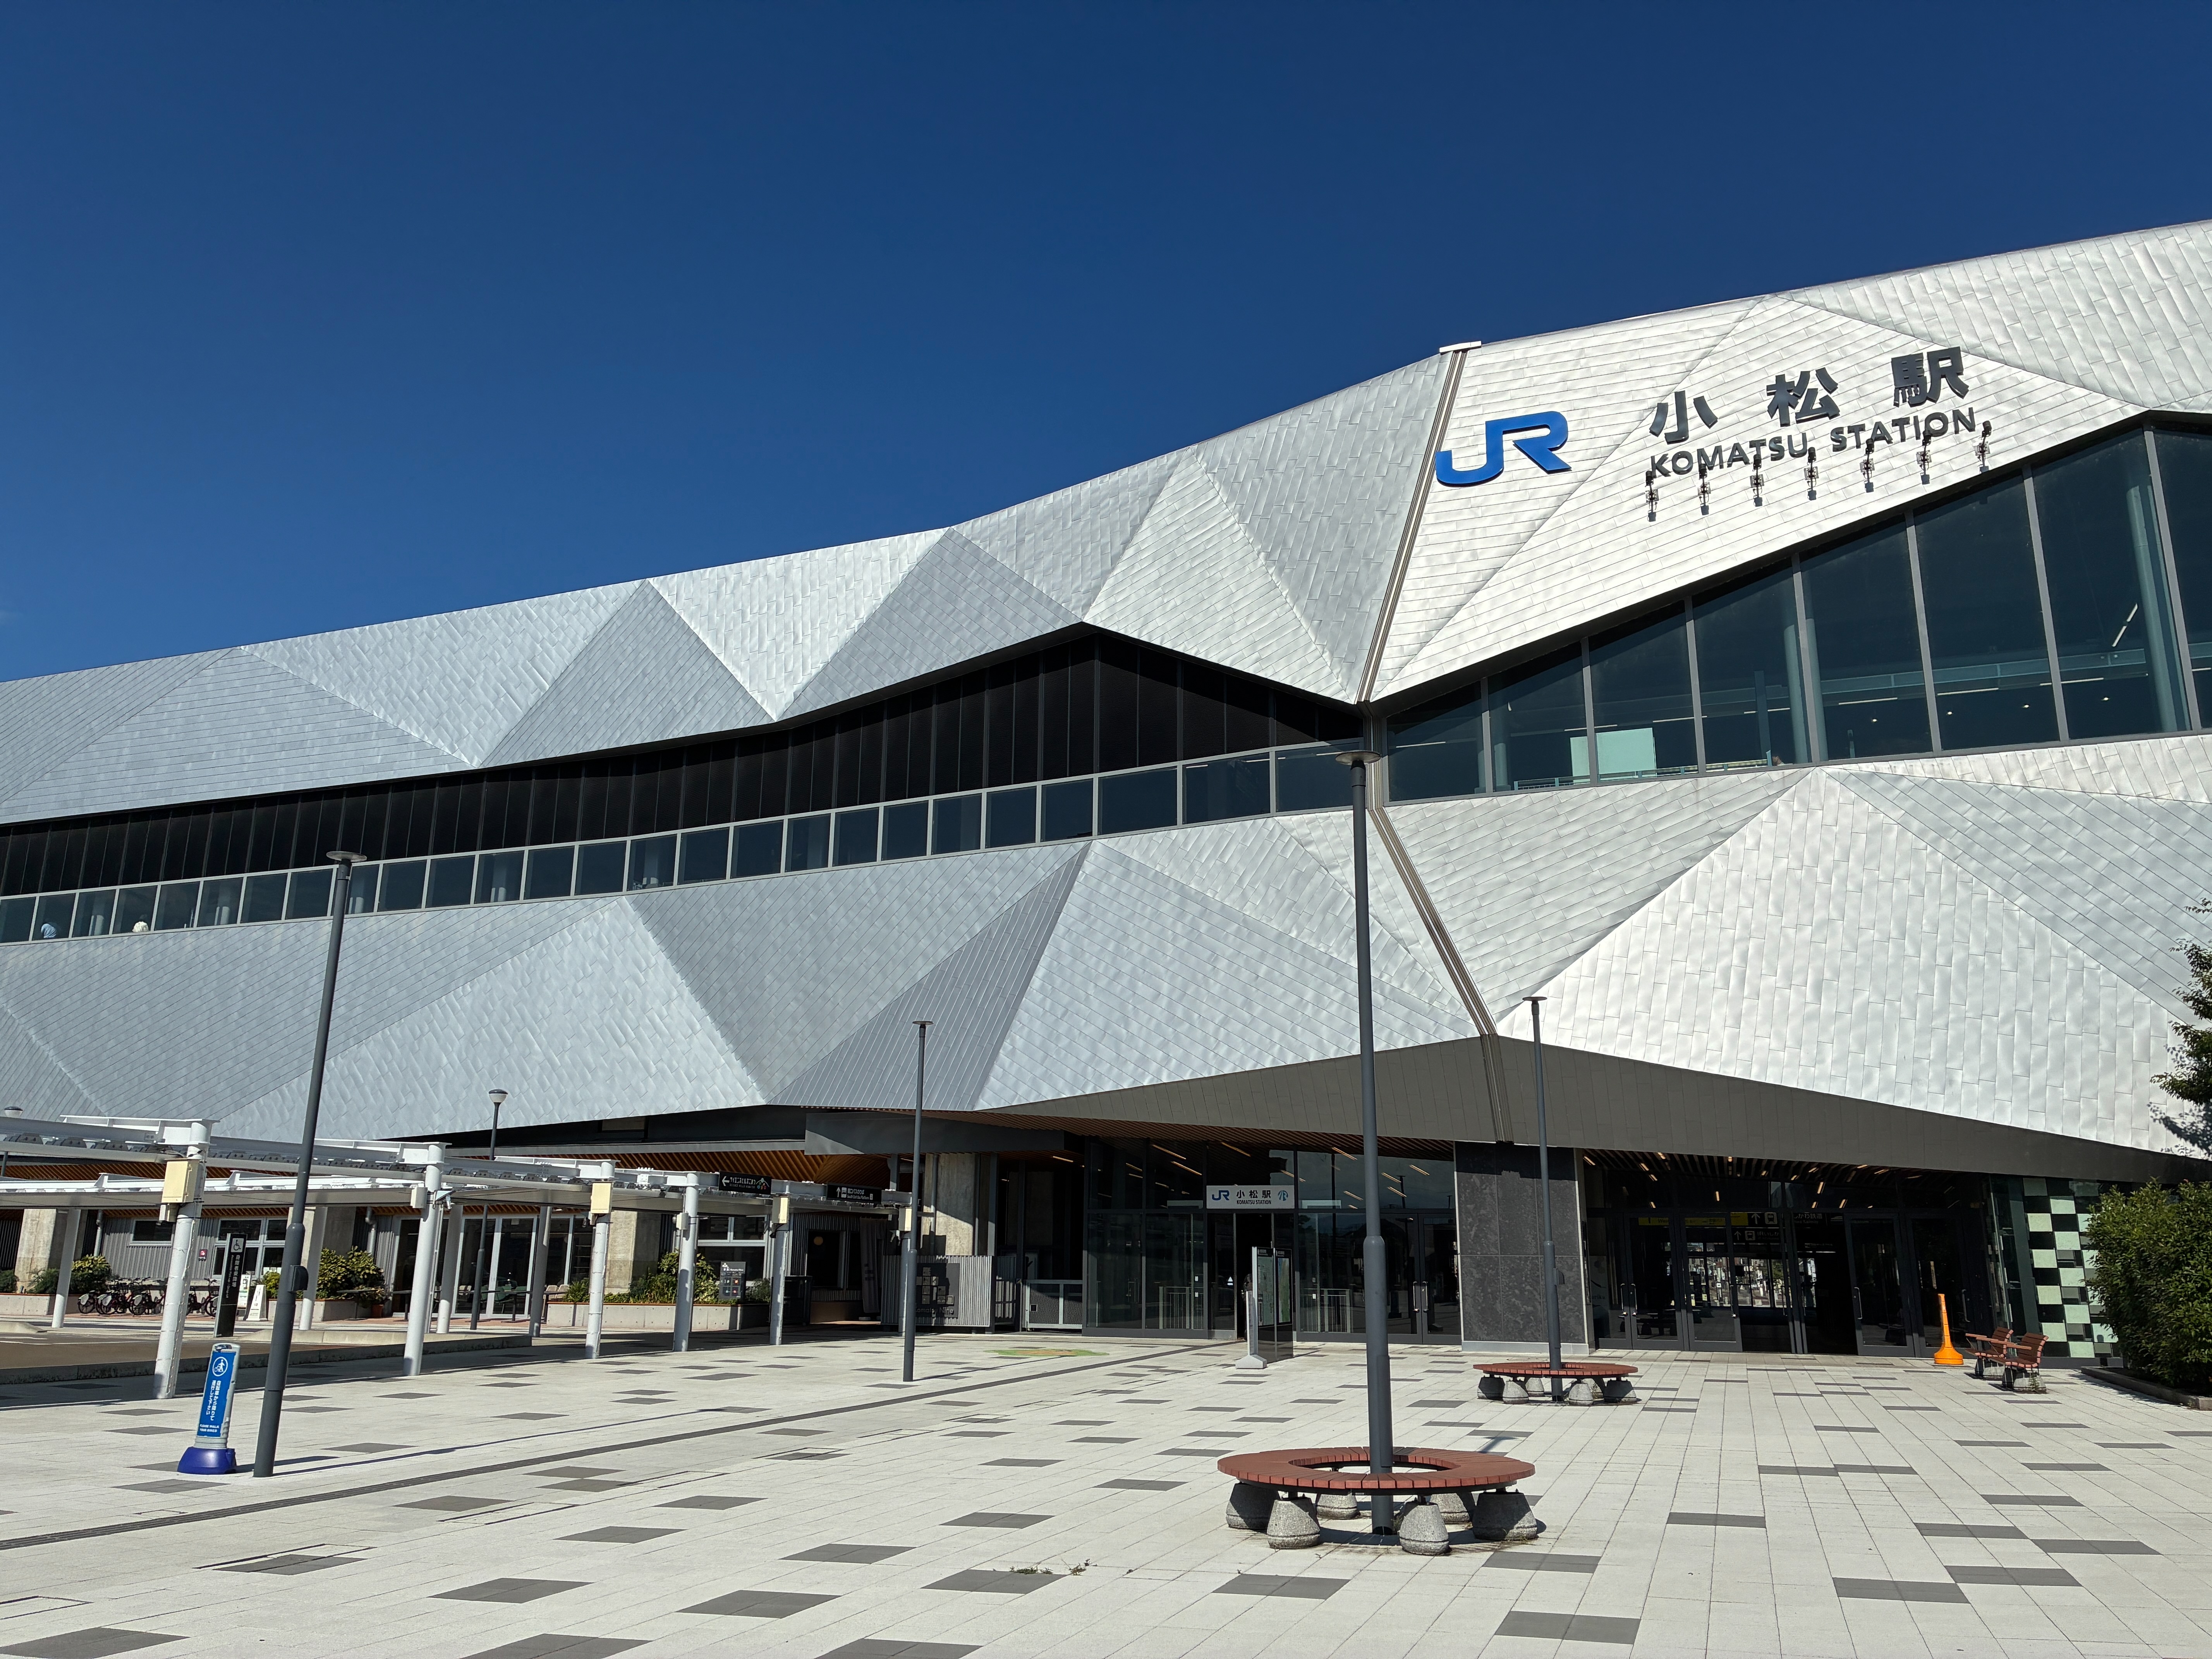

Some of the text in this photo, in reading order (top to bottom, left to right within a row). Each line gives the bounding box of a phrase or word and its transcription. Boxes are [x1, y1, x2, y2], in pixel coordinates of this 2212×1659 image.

[1649, 347, 1969, 445] 小松駅
[1436, 411, 1572, 488] JR
[1651, 407, 1975, 479] KOMATSU STATION
[1212, 1190, 1230, 1200] JR
[1236, 1190, 1271, 1199] 小松駅
